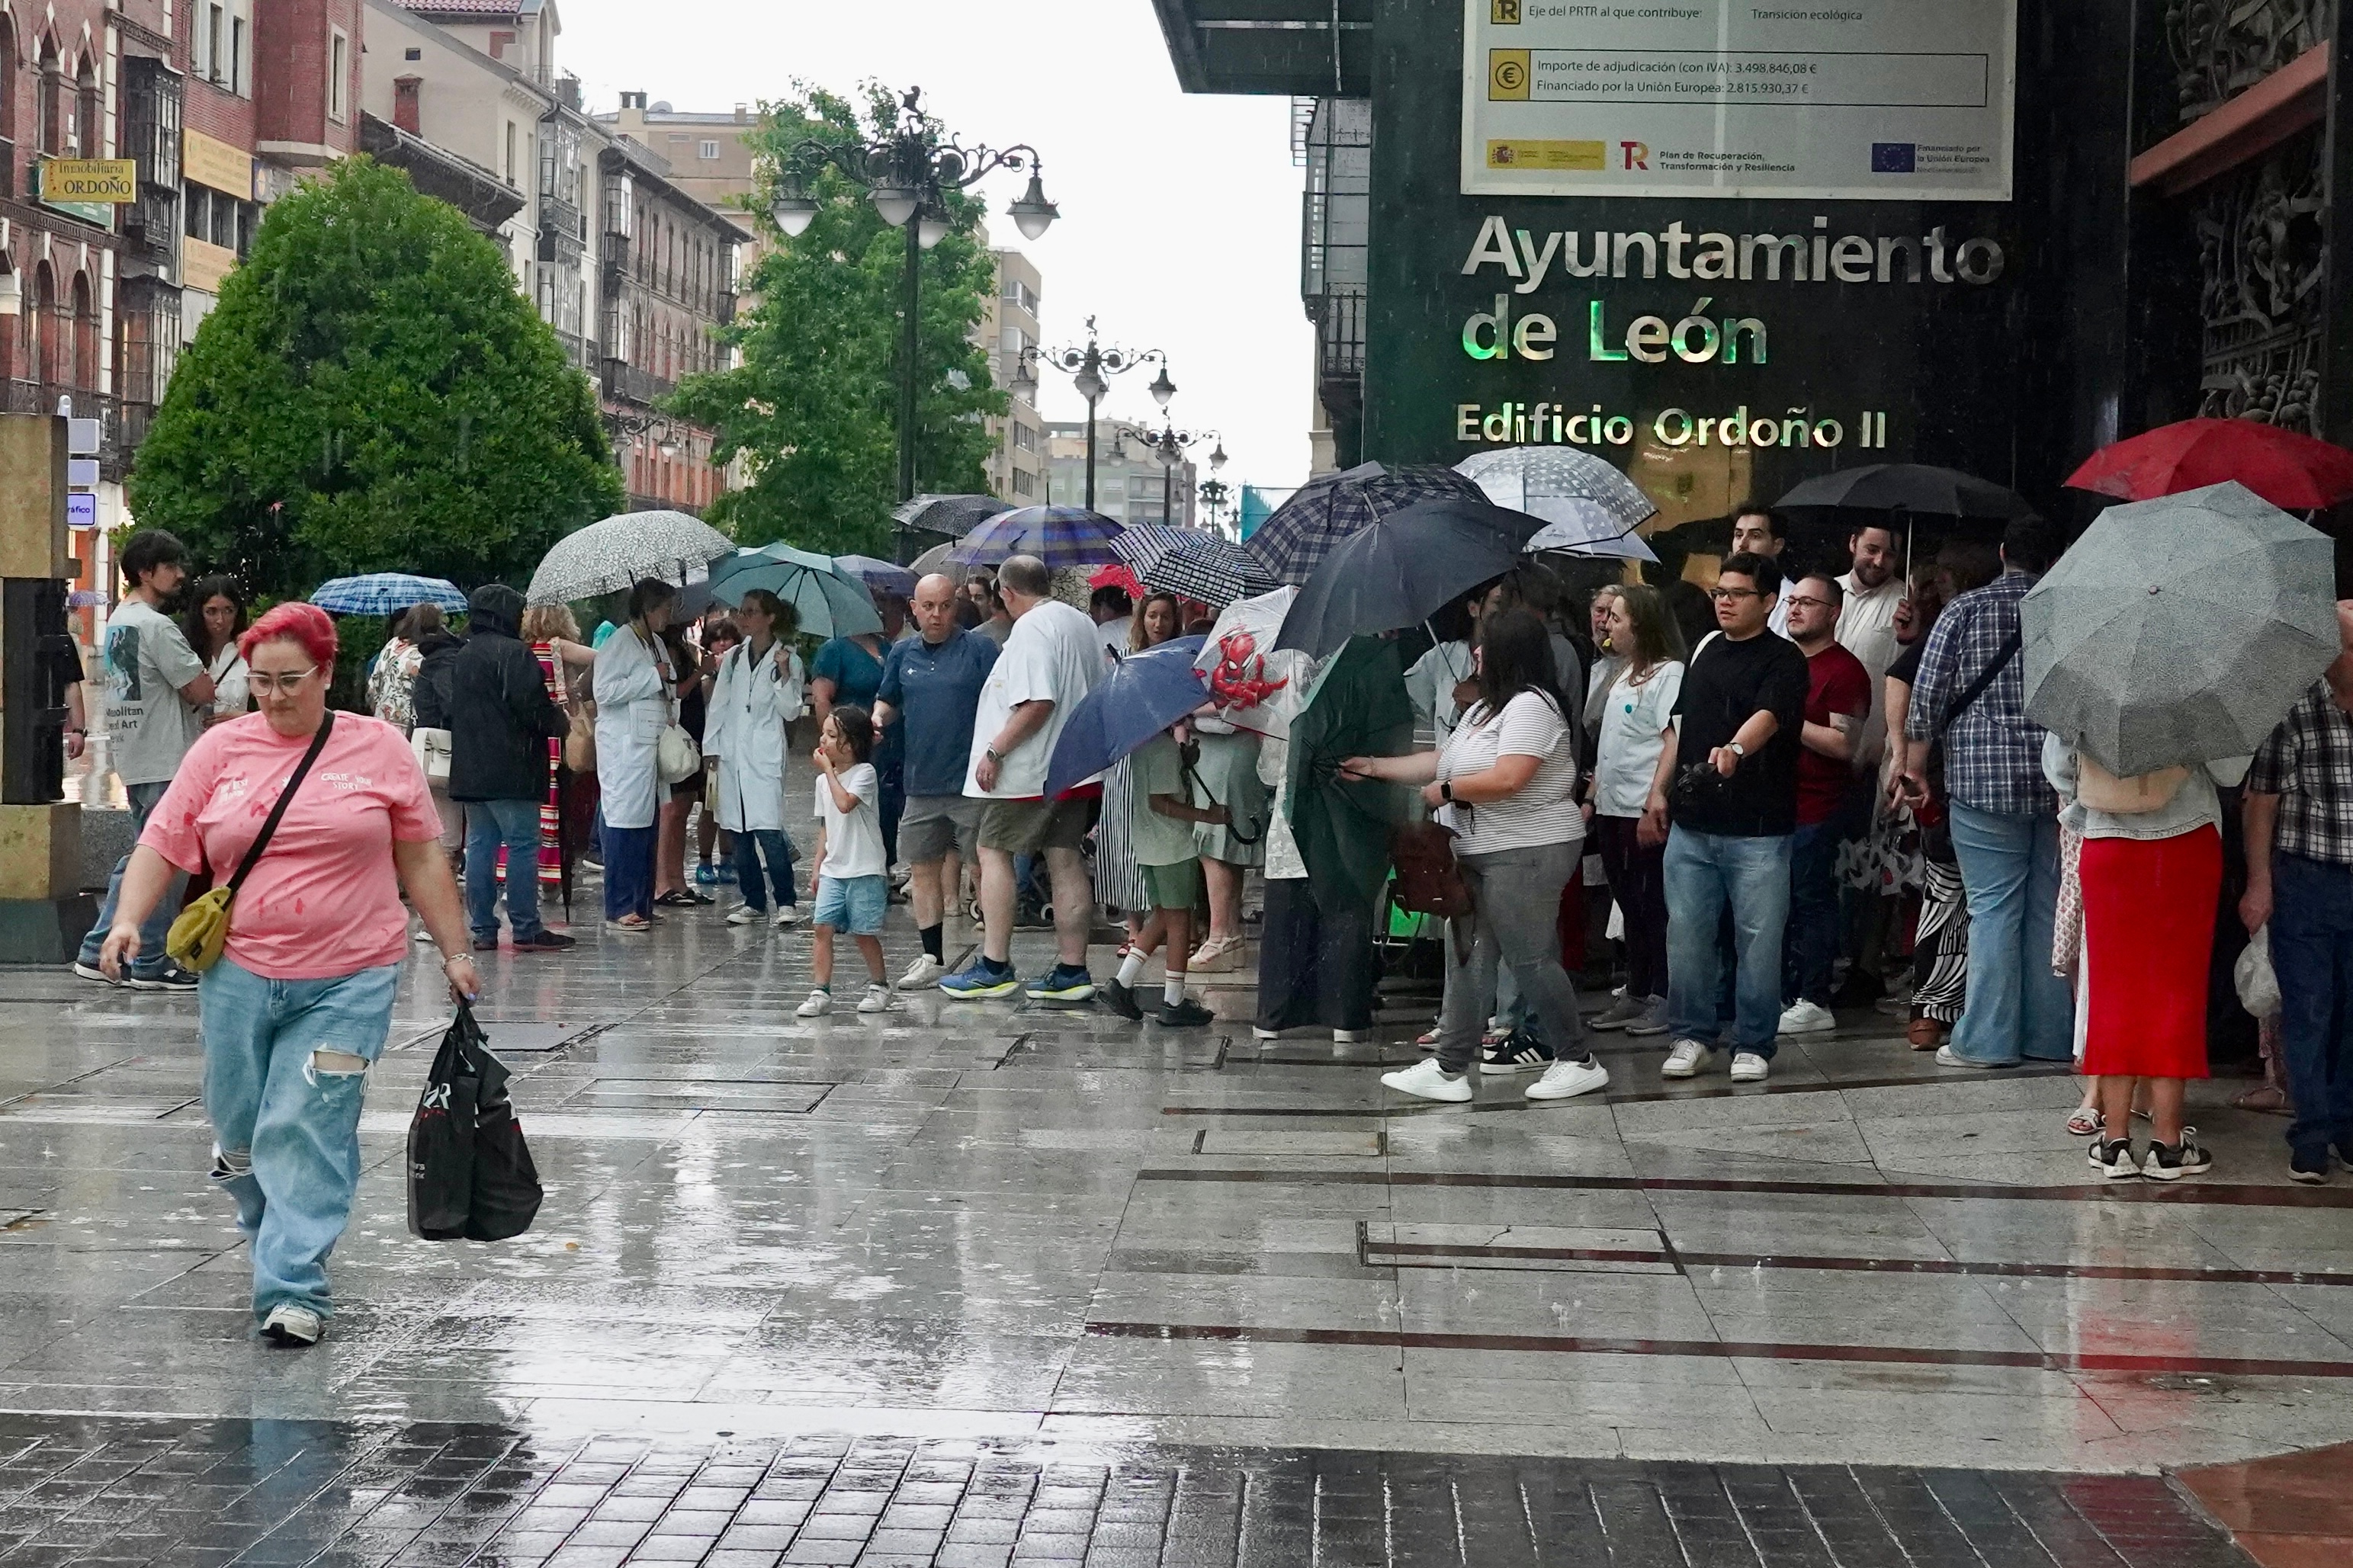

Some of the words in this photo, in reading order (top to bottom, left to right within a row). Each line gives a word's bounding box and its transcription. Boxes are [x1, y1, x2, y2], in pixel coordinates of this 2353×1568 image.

[1529, 6, 1546, 19] Eje
[1549, 6, 1565, 16] del
[1569, 6, 1598, 17] PRTR
[1600, 7, 1610, 17] al
[1613, 9, 1635, 19] que
[1638, 8, 1703, 20] contribuye:
[1810, 9, 1863, 22] ecológica
[1538, 60, 1583, 72] Importe
[1586, 61, 1600, 72] de
[1603, 61, 1676, 74] adjudicación
[1679, 62, 1703, 74] (con
[1706, 63, 1732, 74] IVA):
[1735, 63, 1807, 75] 3.498.846,08
[1809, 63, 1817, 74] €
[1537, 80, 1599, 91] Financiado
[1602, 82, 1622, 94] por
[1625, 81, 1634, 91] la
[1637, 82, 1671, 92] Unión
[1674, 82, 1725, 95] Europea:
[1726, 82, 1799, 95] 2.815.930,37
[1801, 83, 1809, 94] €
[1660, 151, 1680, 159] Plan
[1683, 151, 1695, 159] de
[59, 162, 124, 174] Inmobiliaria
[1660, 162, 1733, 171] Transformación
[1736, 164, 1742, 172] y
[1745, 162, 1796, 172] Resiliencia
[64, 175, 131, 194] ORDOÑO
[1461, 215, 2005, 293] Ayuntamiento
[1462, 293, 1557, 360] de
[1590, 297, 1767, 364] León
[1456, 402, 1634, 444] Edificio
[1653, 406, 1844, 448] Ordoño
[1861, 411, 1886, 448] II
[332, 781, 358, 790] STORY
